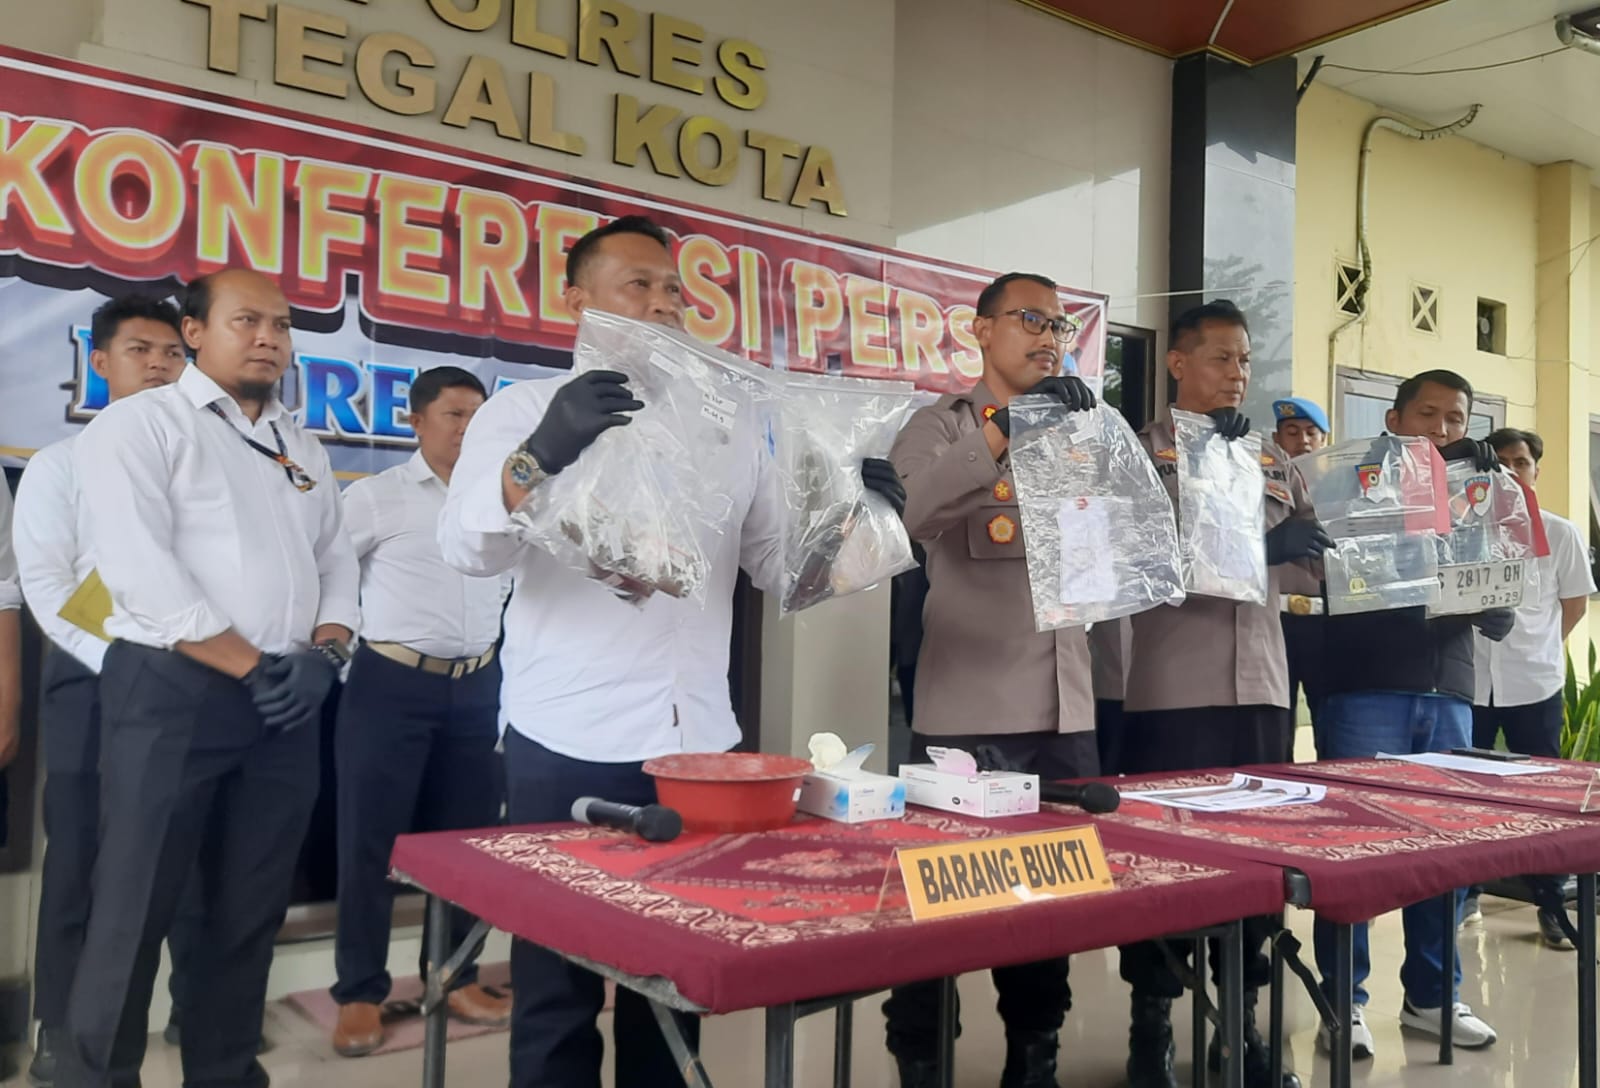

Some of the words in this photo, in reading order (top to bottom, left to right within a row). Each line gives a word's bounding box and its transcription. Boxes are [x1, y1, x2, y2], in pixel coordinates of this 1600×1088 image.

[180, 0, 583, 157] TEGAL
[613, 93, 848, 217] KOTA
[346, 0, 767, 111] LRES
[0, 118, 763, 353] KONFERESI
[791, 263, 985, 379] PERS
[1457, 567, 1490, 589] 2817
[917, 848, 1020, 904] BARANG
[1020, 839, 1094, 888] BUKTI
